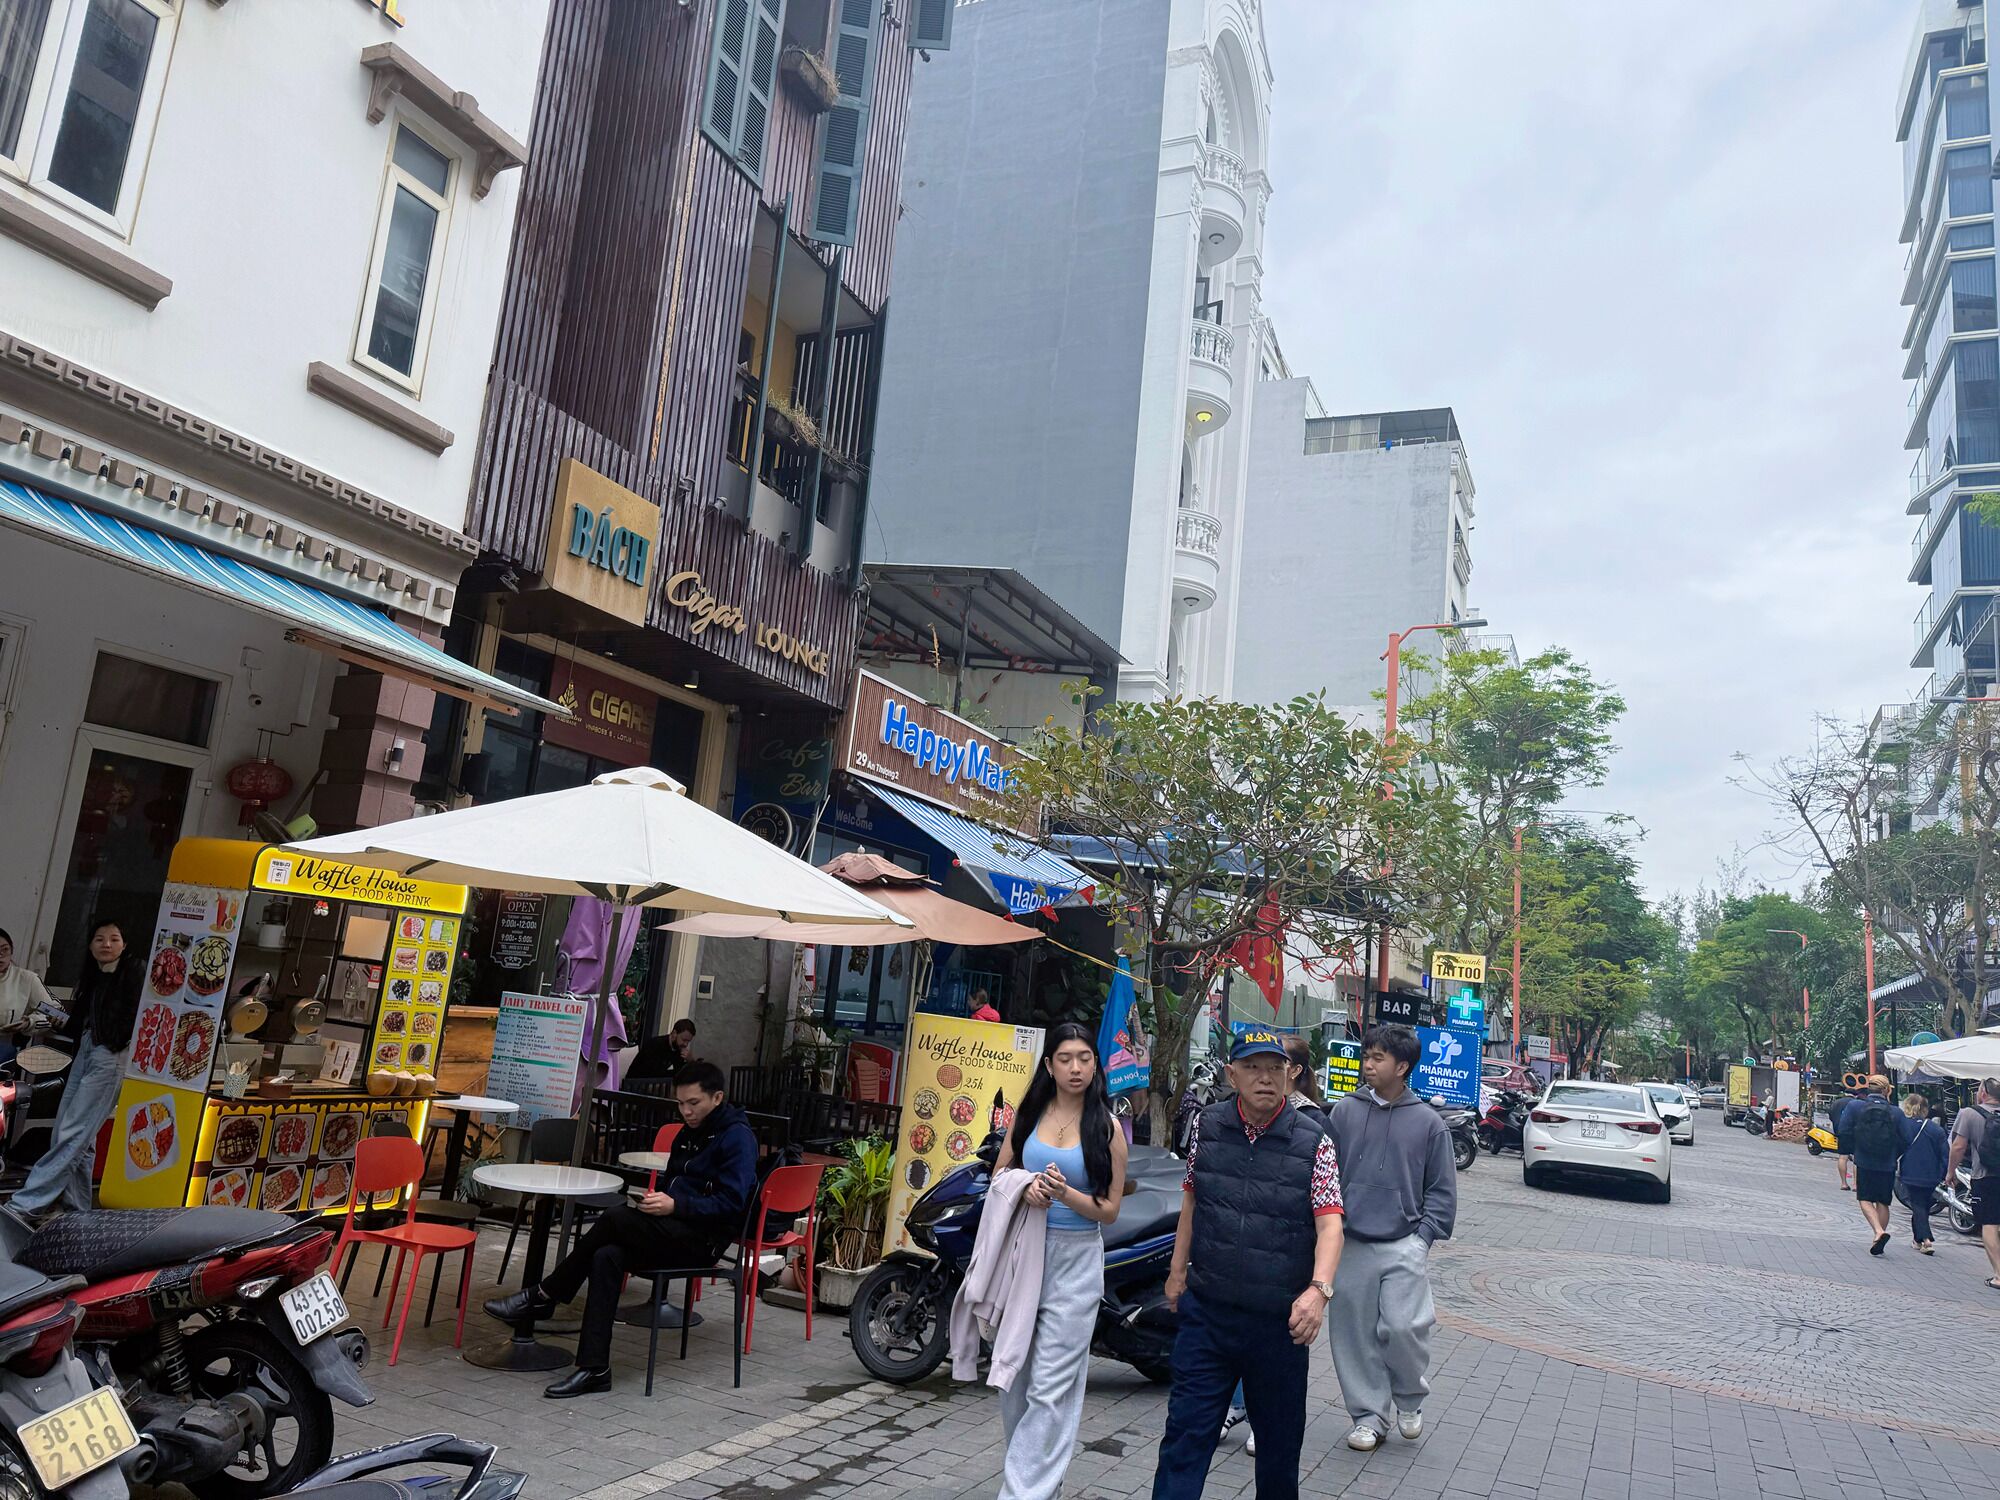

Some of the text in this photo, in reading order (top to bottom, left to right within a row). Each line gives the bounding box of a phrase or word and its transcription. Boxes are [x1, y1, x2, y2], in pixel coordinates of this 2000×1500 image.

[569, 503, 651, 587] BÁCH
[666, 571, 829, 677] Cigar LOUNGE
[880, 699, 966, 784] Happy
[760, 740, 828, 768] Café
[856, 751, 868, 767] 29
[867, 760, 876, 770] An
[780, 773, 822, 796] Bar
[835, 810, 873, 831] Welcome
[296, 859, 417, 894] Waffle House
[352, 887, 432, 908] FOOD & DRINK
[507, 901, 536, 912] OPEN
[1010, 883, 1054, 911] Happy
[1437, 964, 1481, 979] TATTOO
[503, 997, 526, 1007] JAHY
[529, 1000, 562, 1012] TRAVEL
[565, 1005, 582, 1014] CAR
[1382, 1001, 1411, 1015] BAR
[918, 1034, 1013, 1062] Waffle House
[1245, 1032, 1278, 1045] NAVY
[960, 1057, 1026, 1075] FOOD & DRINK
[1330, 1057, 1347, 1068] SWEET
[1420, 1065, 1469, 1079] PHARMACY
[963, 1077, 983, 1090] 25k
[1429, 1077, 1459, 1089] SWEET
[290, 1277, 331, 1313] 43-E1
[296, 1298, 346, 1341] 002.58
[35, 1396, 110, 1451] 38-T1
[50, 1425, 123, 1481] 2168
